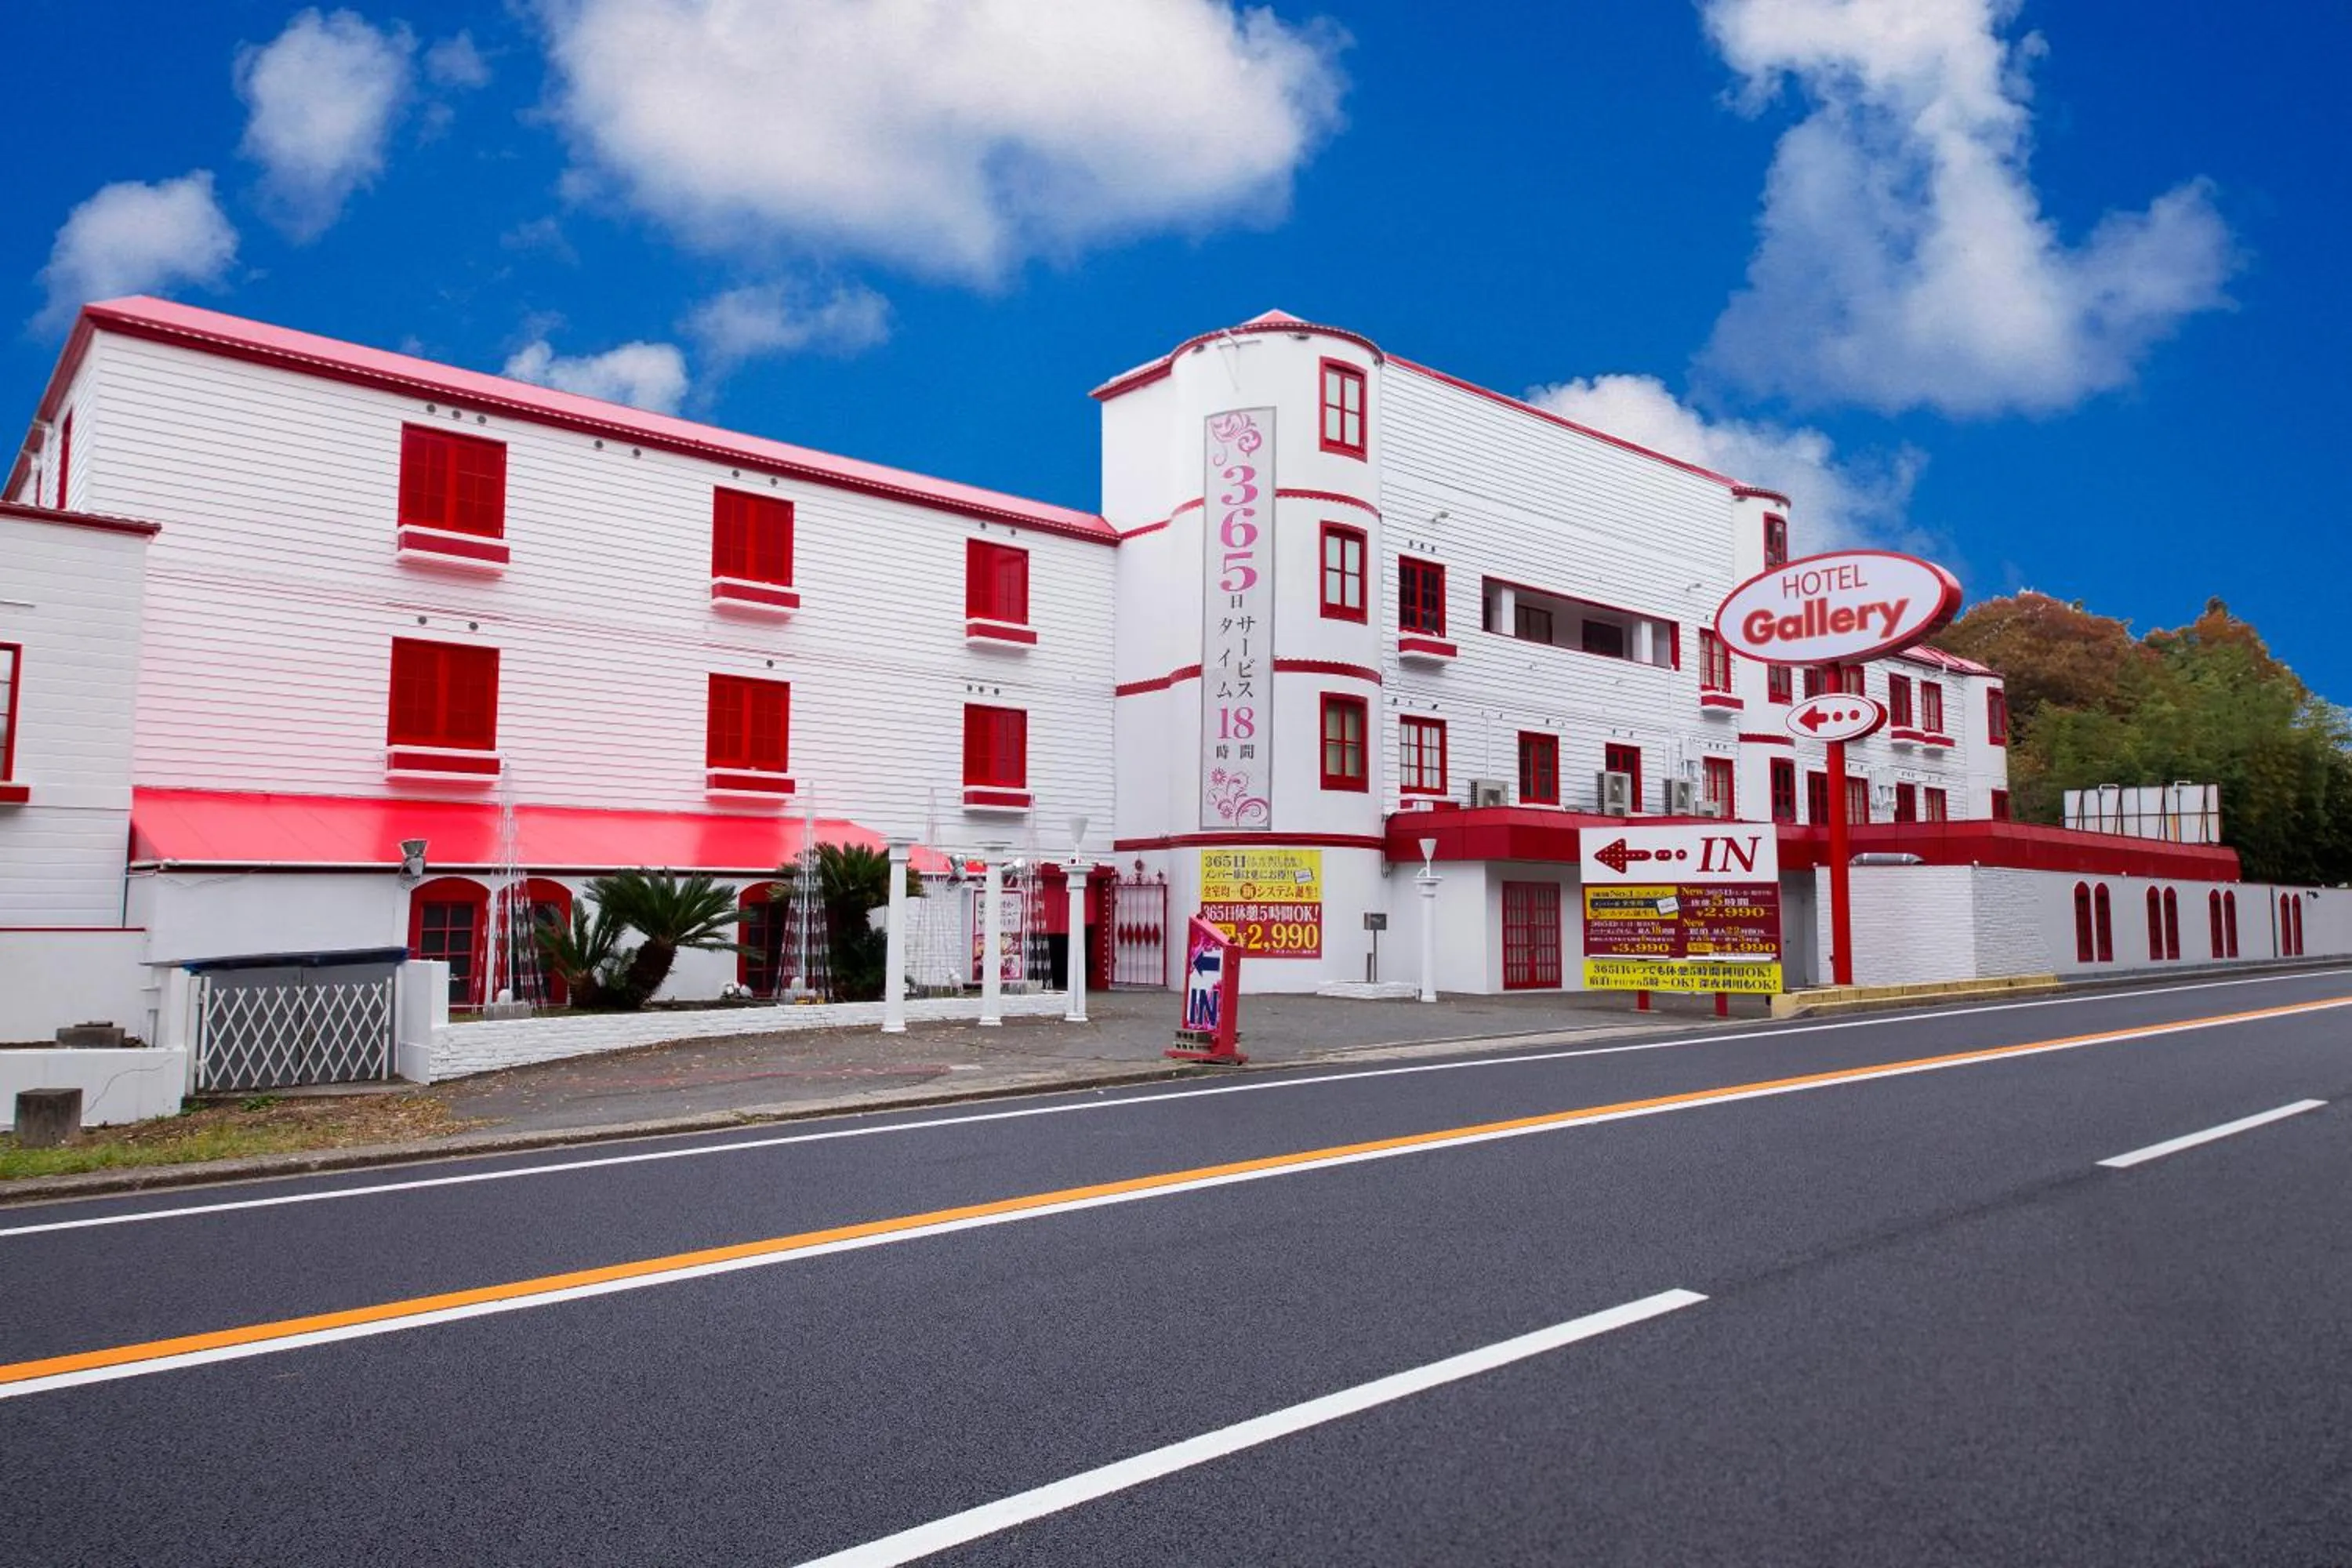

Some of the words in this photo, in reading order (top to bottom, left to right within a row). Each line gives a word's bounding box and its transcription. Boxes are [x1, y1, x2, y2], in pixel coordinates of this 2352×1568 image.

[1782, 564, 1868, 599] HOTEL
[1743, 597, 1910, 645] Gallery
[1217, 617, 1232, 698] タイム
[1236, 616, 1256, 699] サービス
[1218, 706, 1255, 739] 18
[1696, 837, 1762, 873] IN
[1189, 988, 1219, 1026] IN
